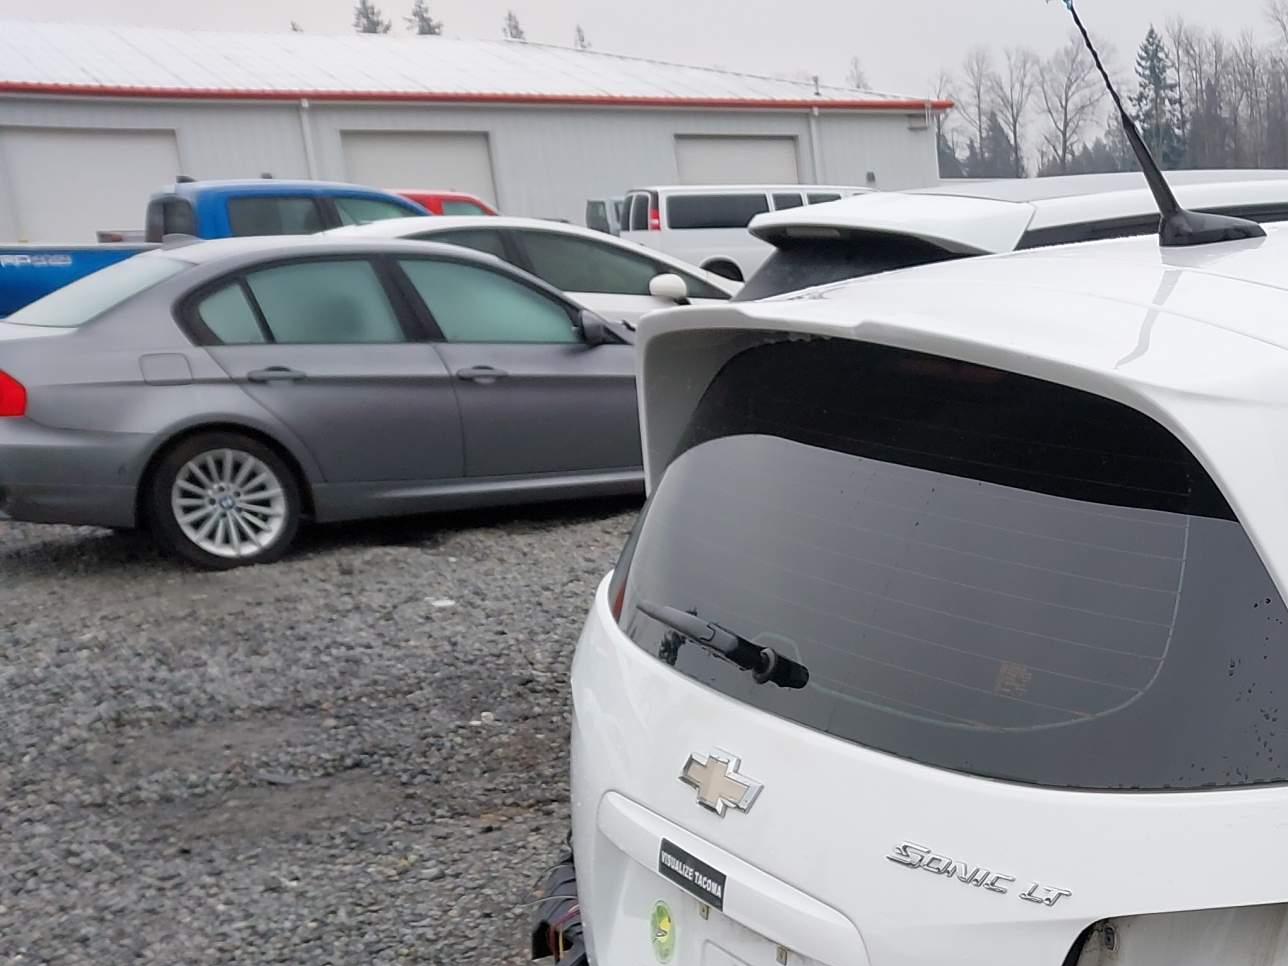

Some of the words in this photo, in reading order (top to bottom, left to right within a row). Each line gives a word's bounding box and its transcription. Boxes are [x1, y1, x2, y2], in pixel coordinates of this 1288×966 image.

[661, 850, 695, 881] VISUALIZE
[694, 871, 722, 899] TACOMA
[886, 840, 1016, 895] SONIC
[1018, 881, 1072, 907] LT
